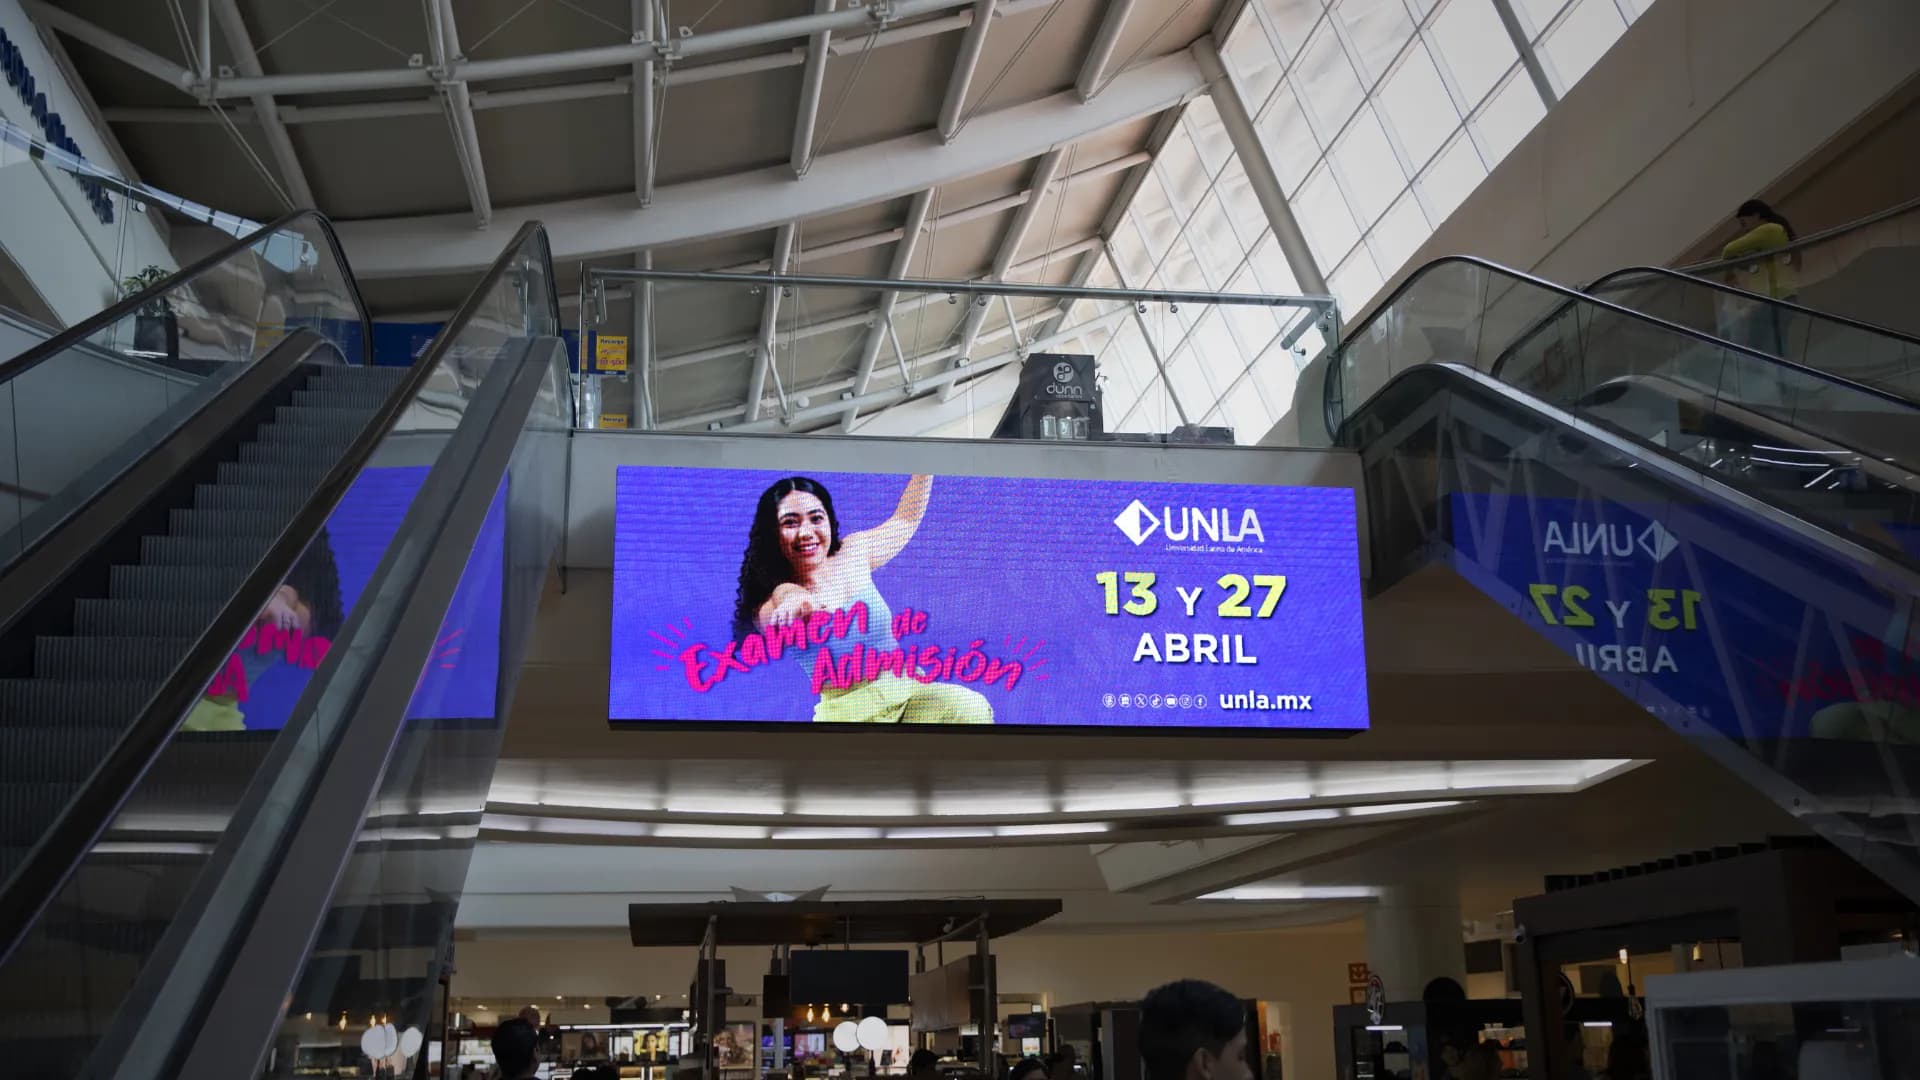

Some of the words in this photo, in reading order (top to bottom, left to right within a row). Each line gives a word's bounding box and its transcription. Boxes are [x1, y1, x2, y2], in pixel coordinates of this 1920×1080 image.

[1164, 506, 1265, 542] UNLA
[1095, 571, 1158, 616] 13
[1175, 587, 1203, 616] Y
[1216, 573, 1287, 618] 27
[679, 601, 868, 693] Examen
[891, 608, 928, 641] de
[811, 639, 1024, 695] Admisión
[1133, 632, 1258, 664] ABRIL
[1219, 689, 1313, 710] unla.mx
